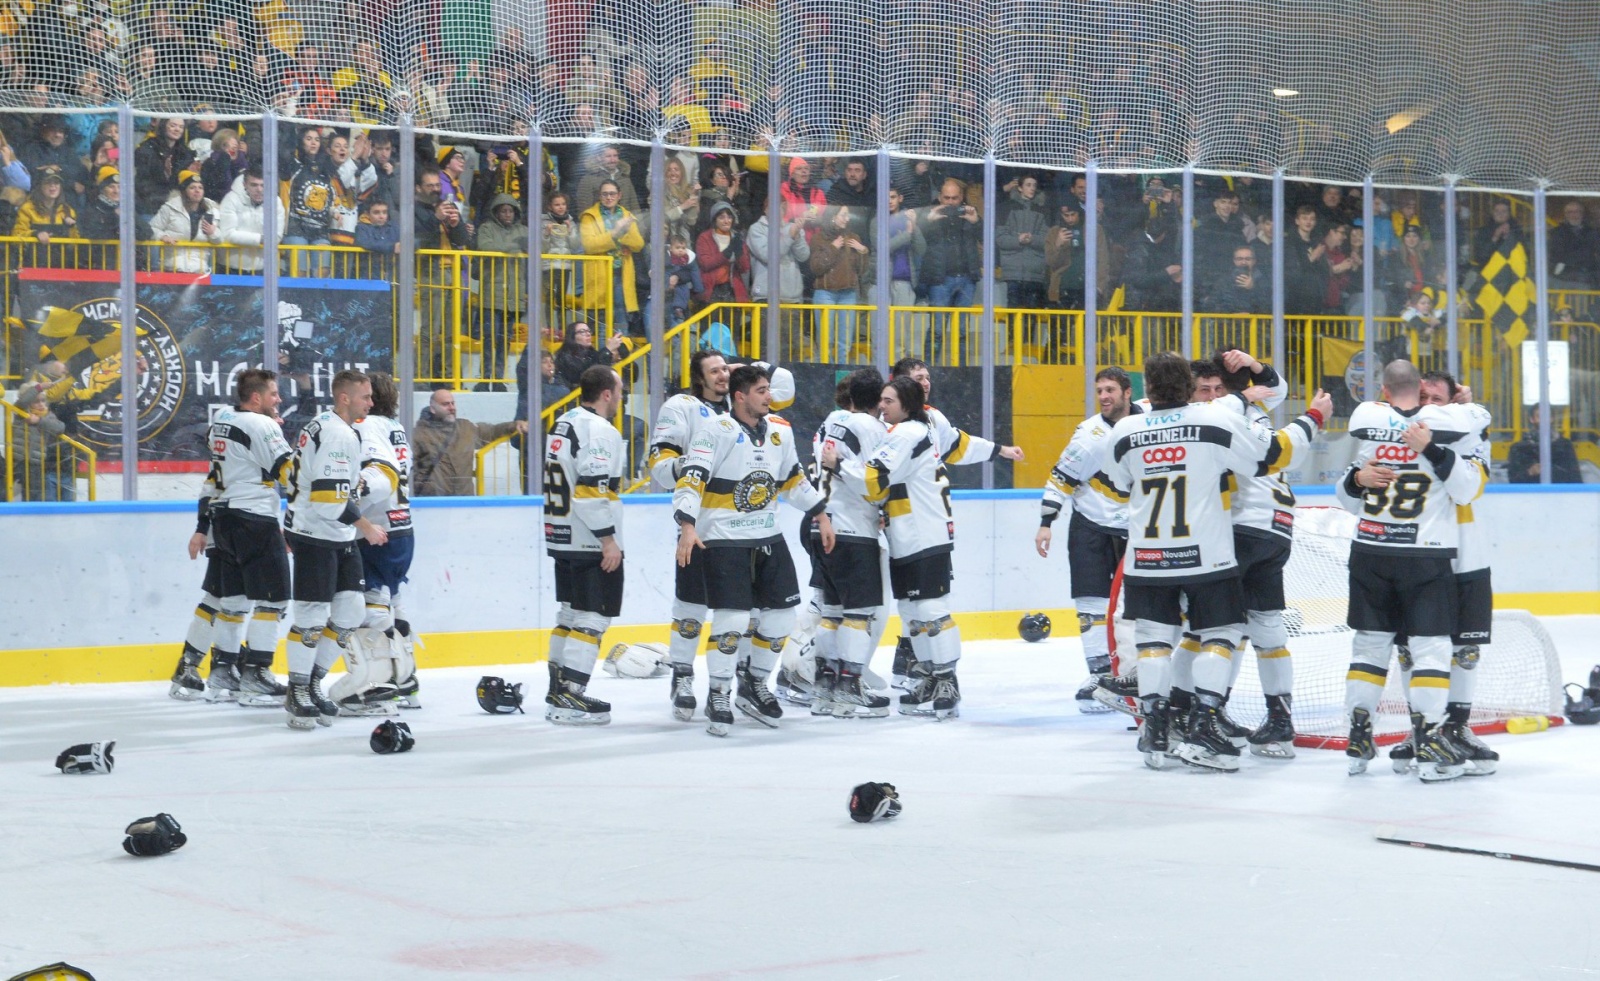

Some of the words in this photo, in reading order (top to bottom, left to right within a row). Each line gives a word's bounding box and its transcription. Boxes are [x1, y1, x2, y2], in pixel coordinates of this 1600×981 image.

[154, 334, 183, 413] HOCKEY
[1129, 426, 1201, 448] PICCINELLI
[1366, 428, 1403, 442] PRIV
[1142, 445, 1187, 464] coop
[1375, 444, 1419, 463] coop
[683, 469, 703, 486] 55
[335, 482, 350, 500] 19
[1141, 474, 1190, 539] 71
[730, 517, 765, 529] Beccaria
[1135, 549, 1162, 561] Gruppo
[1162, 549, 1198, 559] Novauto
[1459, 631, 1490, 639] CCM
